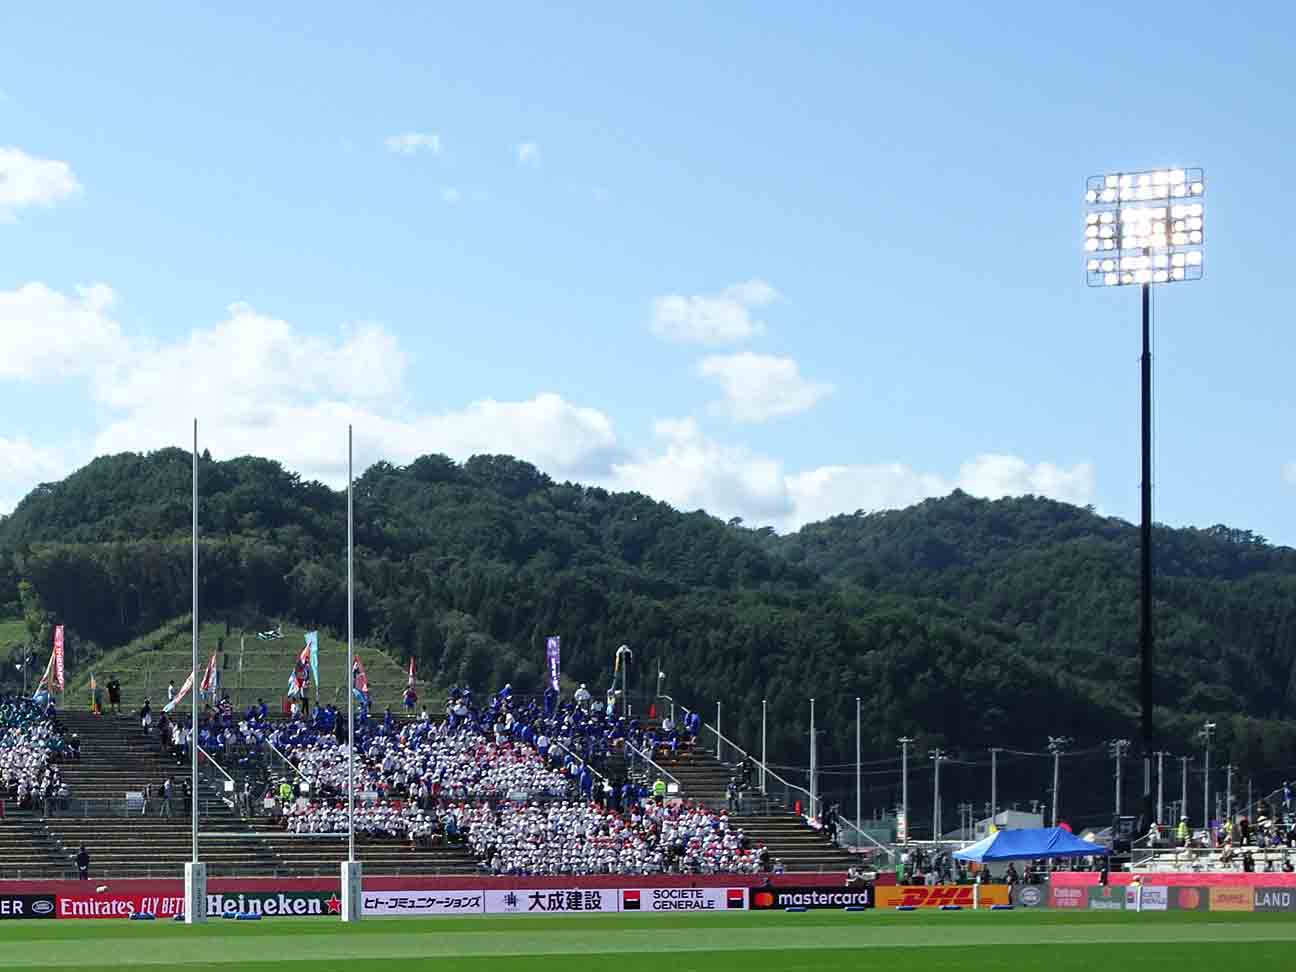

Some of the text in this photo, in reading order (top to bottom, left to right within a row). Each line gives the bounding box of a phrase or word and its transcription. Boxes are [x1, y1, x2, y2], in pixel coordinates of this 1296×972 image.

[528, 890, 603, 911] 大成建設
[653, 889, 704, 899] SOCIETE
[778, 890, 867, 906] mastercard
[896, 888, 976, 905] DHL
[1254, 892, 1291, 907] LAND
[60, 897, 135, 915] Emirates
[141, 897, 159, 914] FLY
[162, 897, 185, 914] BETT
[206, 894, 322, 915] Heineken
[653, 900, 715, 910] GENERALE
